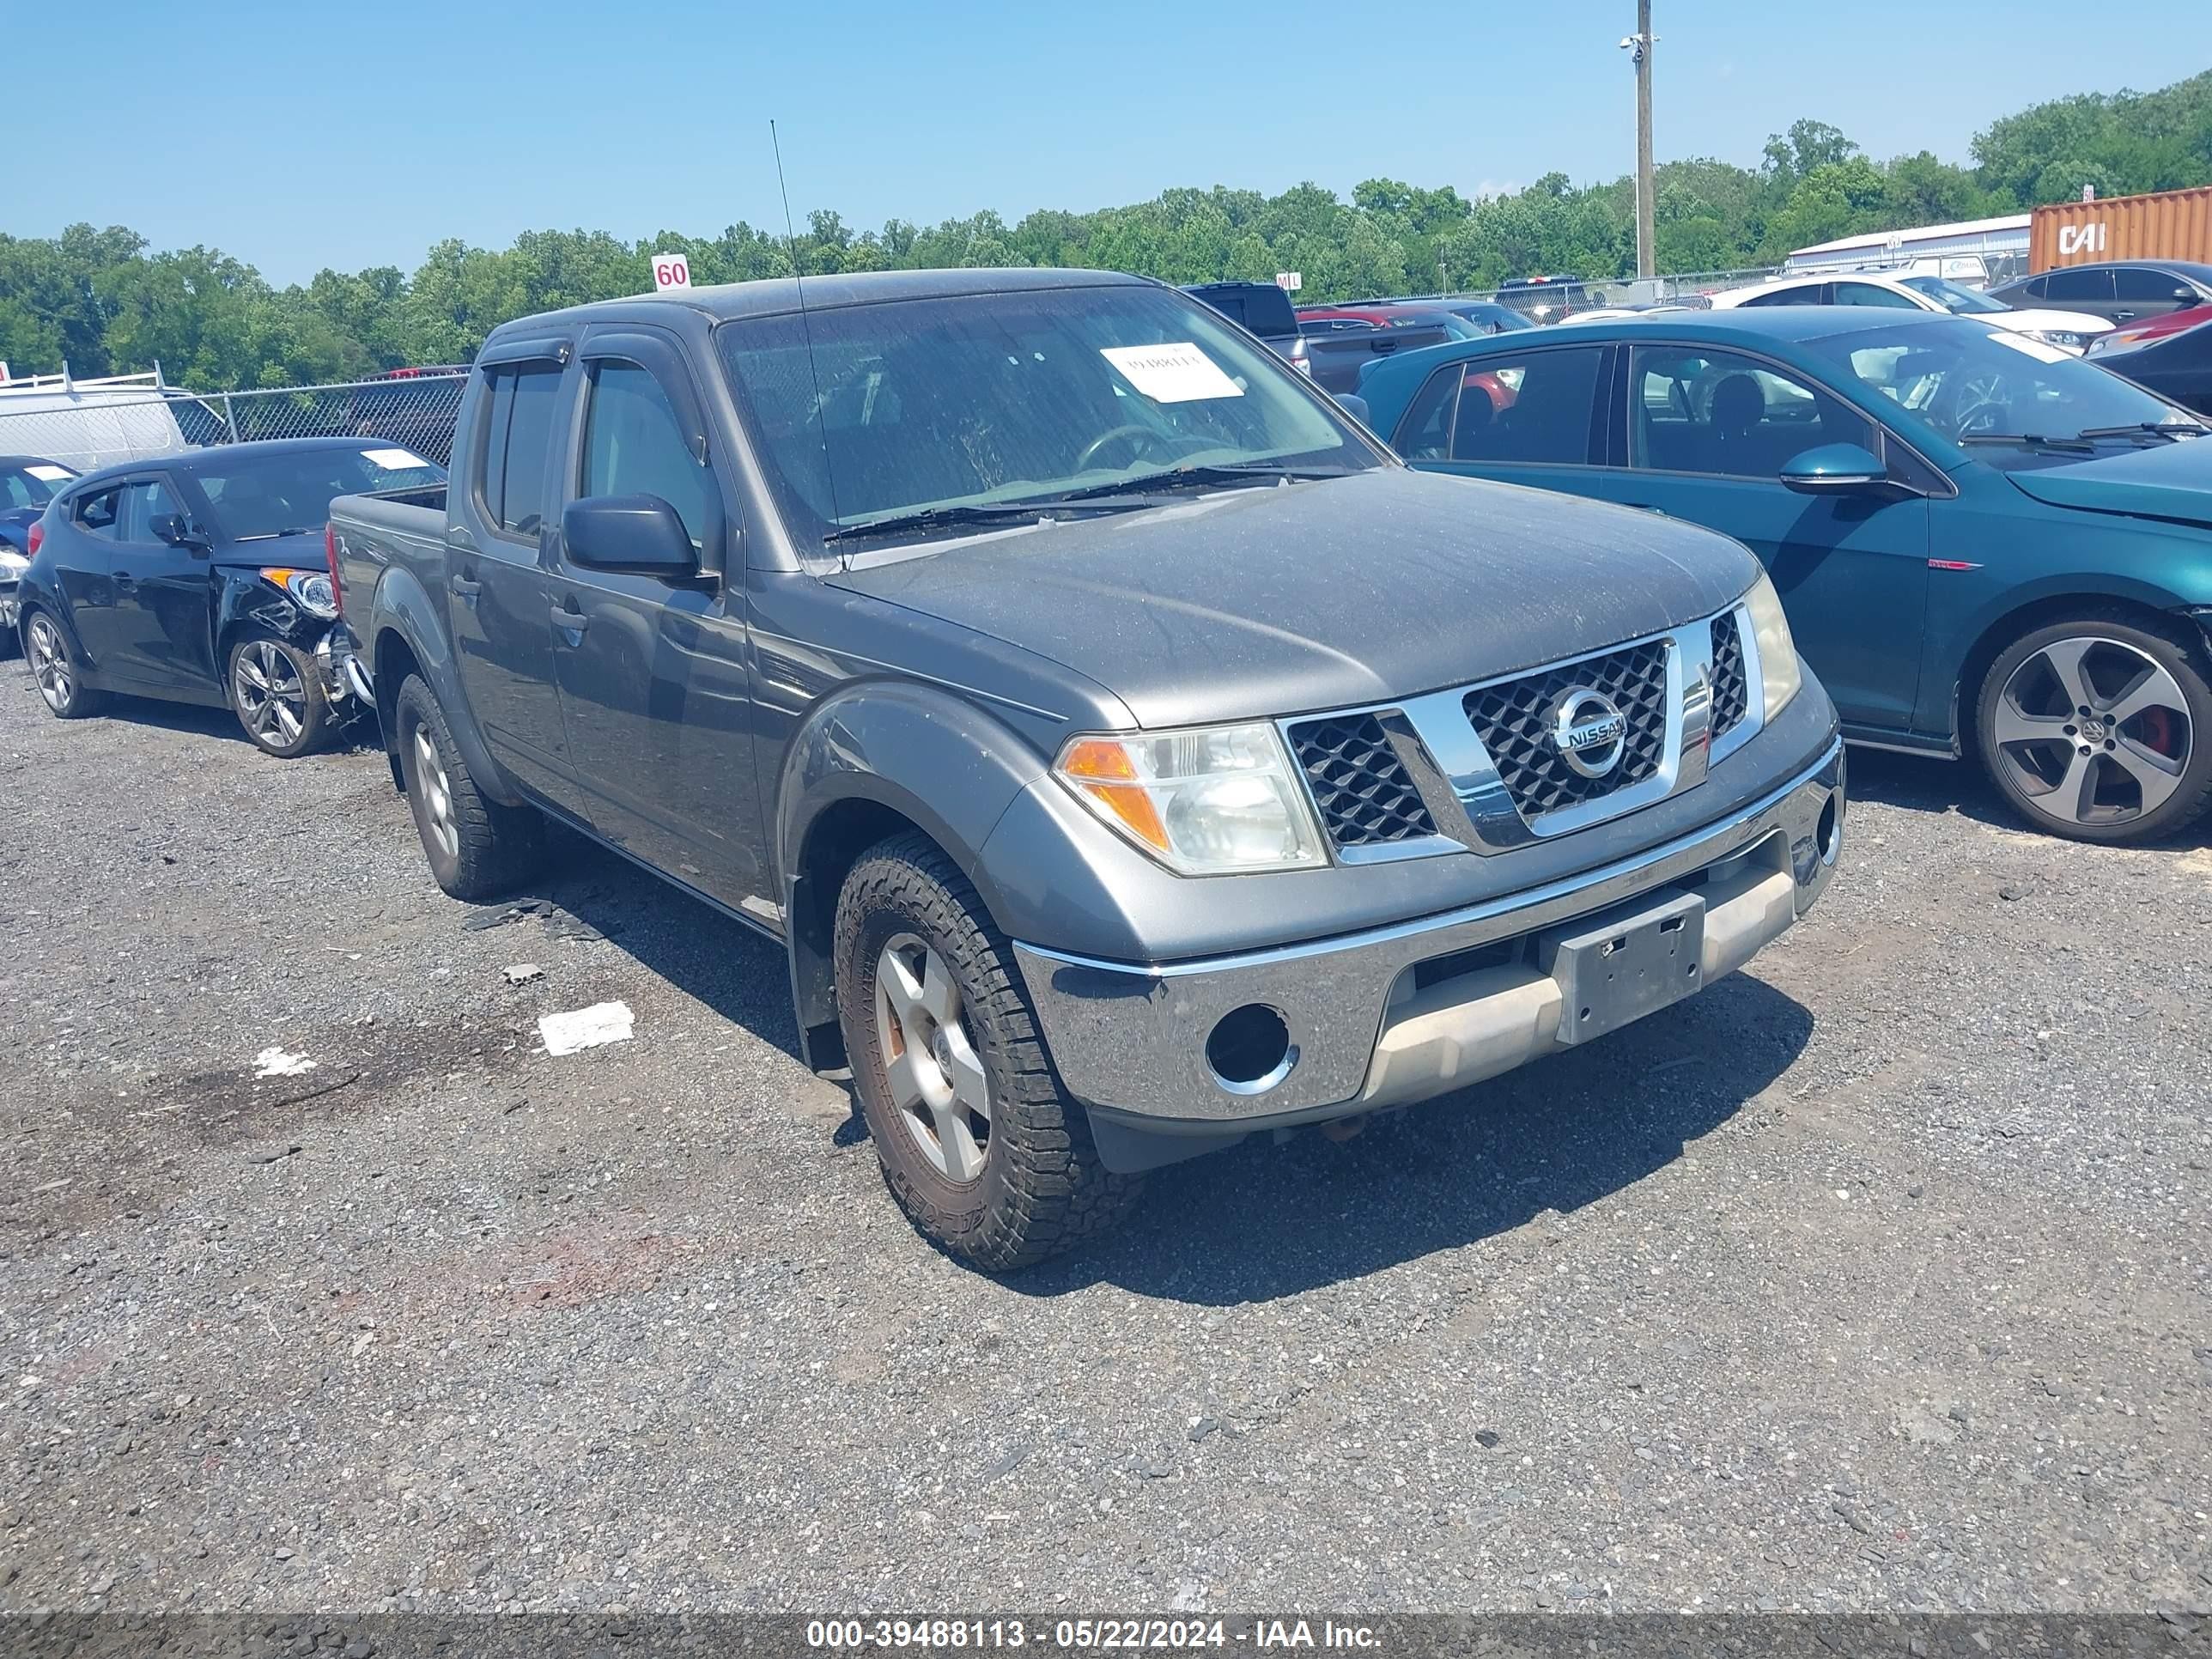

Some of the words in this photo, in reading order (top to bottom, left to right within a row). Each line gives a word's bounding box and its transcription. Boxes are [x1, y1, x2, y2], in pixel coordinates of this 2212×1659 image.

[2059, 223, 2106, 254] CAI
[658, 263, 686, 286] 60
[1568, 718, 1626, 748] NISSAN
